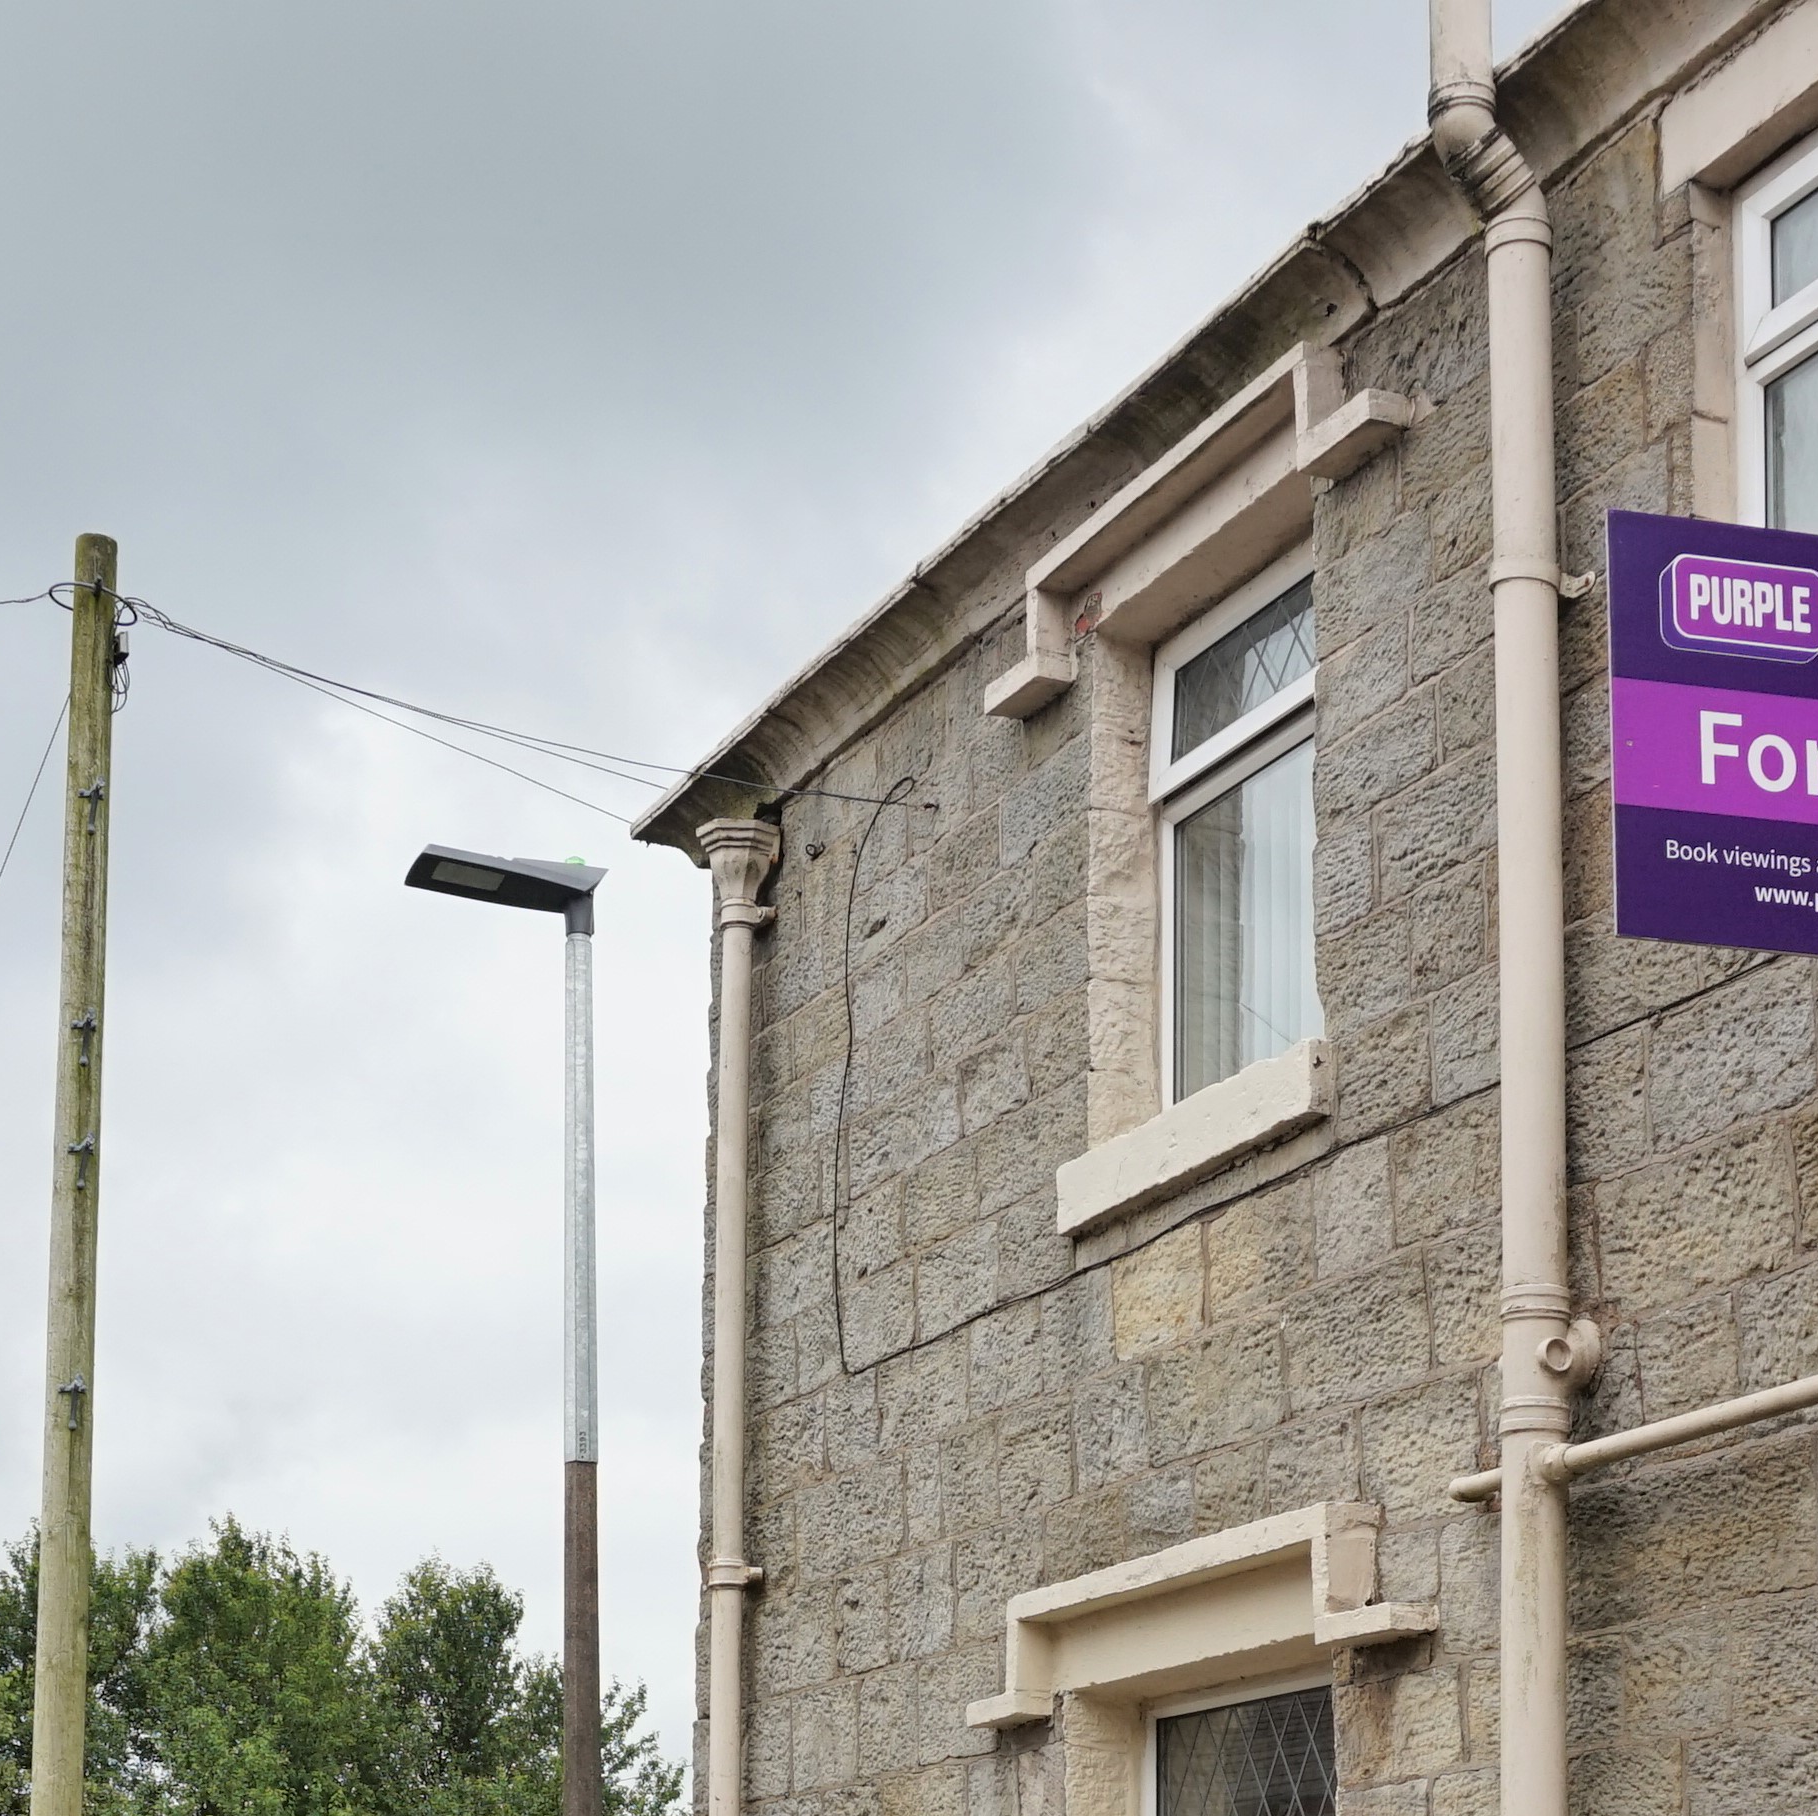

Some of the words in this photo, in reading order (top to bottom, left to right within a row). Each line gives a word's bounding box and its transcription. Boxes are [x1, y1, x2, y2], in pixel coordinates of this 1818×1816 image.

[1689, 573, 1812, 634] PURPLE
[1666, 839, 1718, 865] Book
[1723, 847, 1811, 876] viewings
